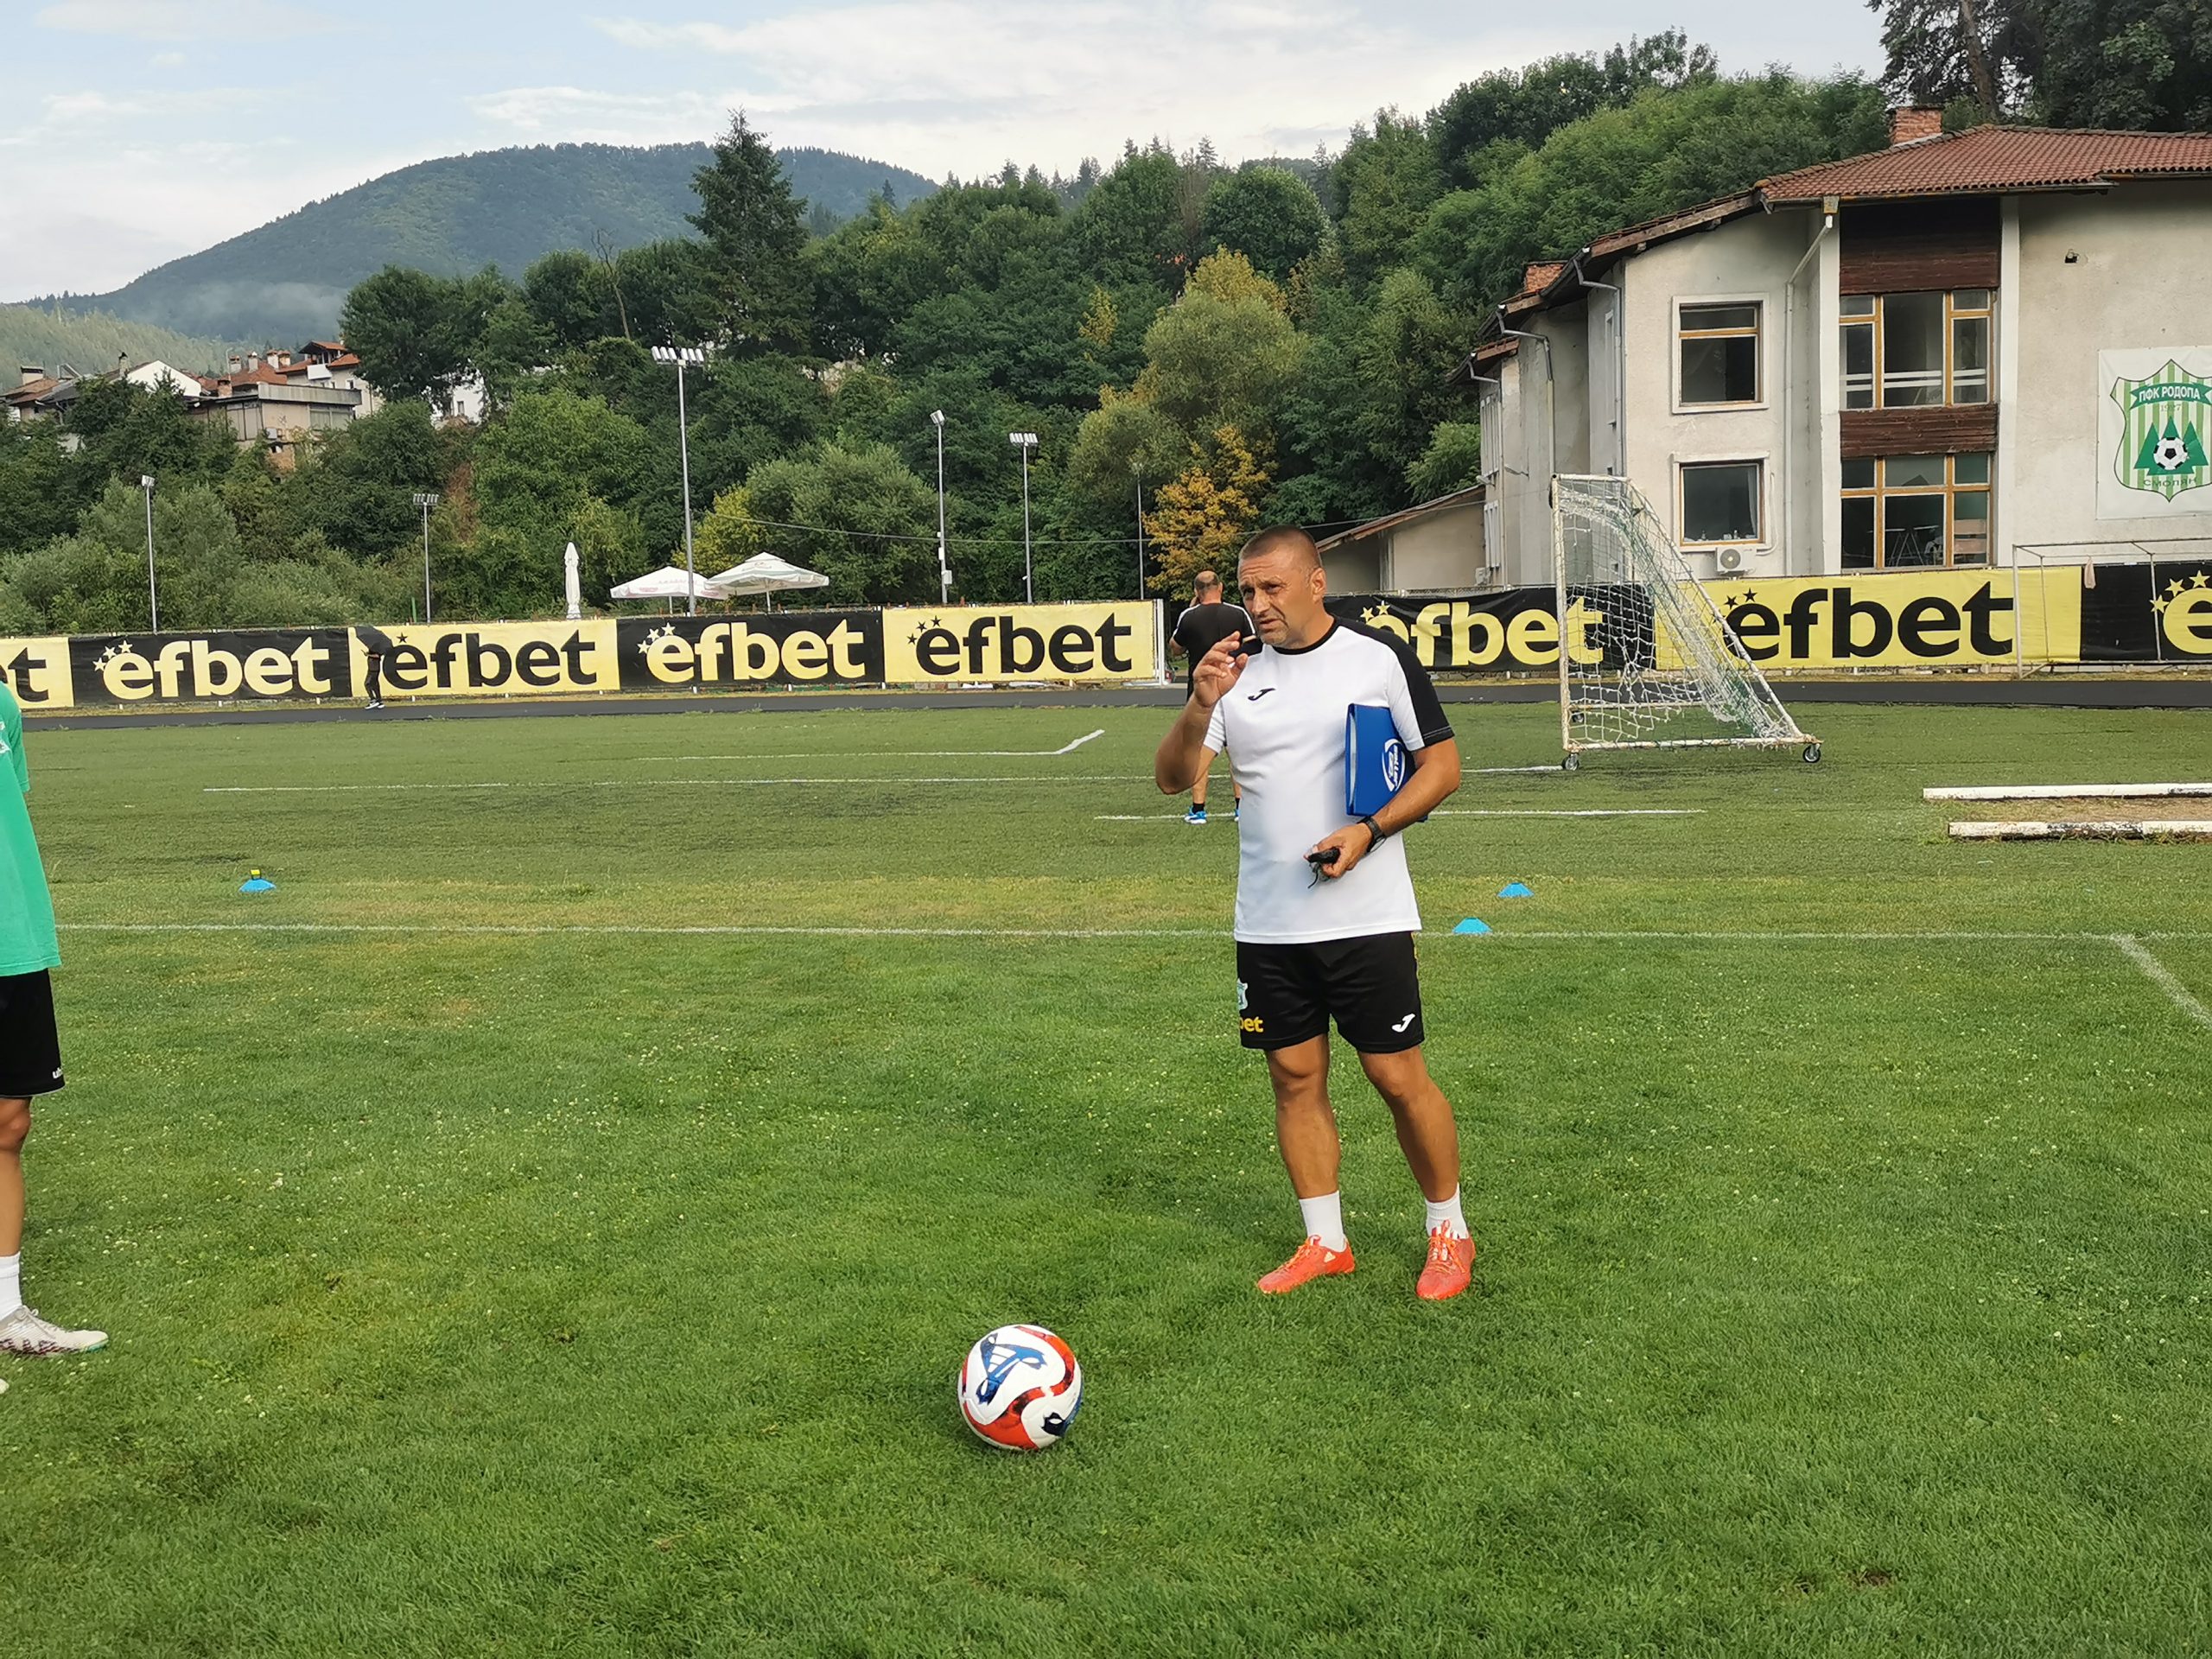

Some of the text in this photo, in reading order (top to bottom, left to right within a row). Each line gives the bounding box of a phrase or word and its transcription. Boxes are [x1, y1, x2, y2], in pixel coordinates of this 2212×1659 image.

[2139, 385, 2201, 403] ПФК РОДОПА
[646, 619, 865, 683] efbet
[916, 612, 1132, 676] efbet
[1723, 581, 2014, 661] efbet
[103, 636, 331, 700] efbet
[383, 630, 598, 690] efbet
